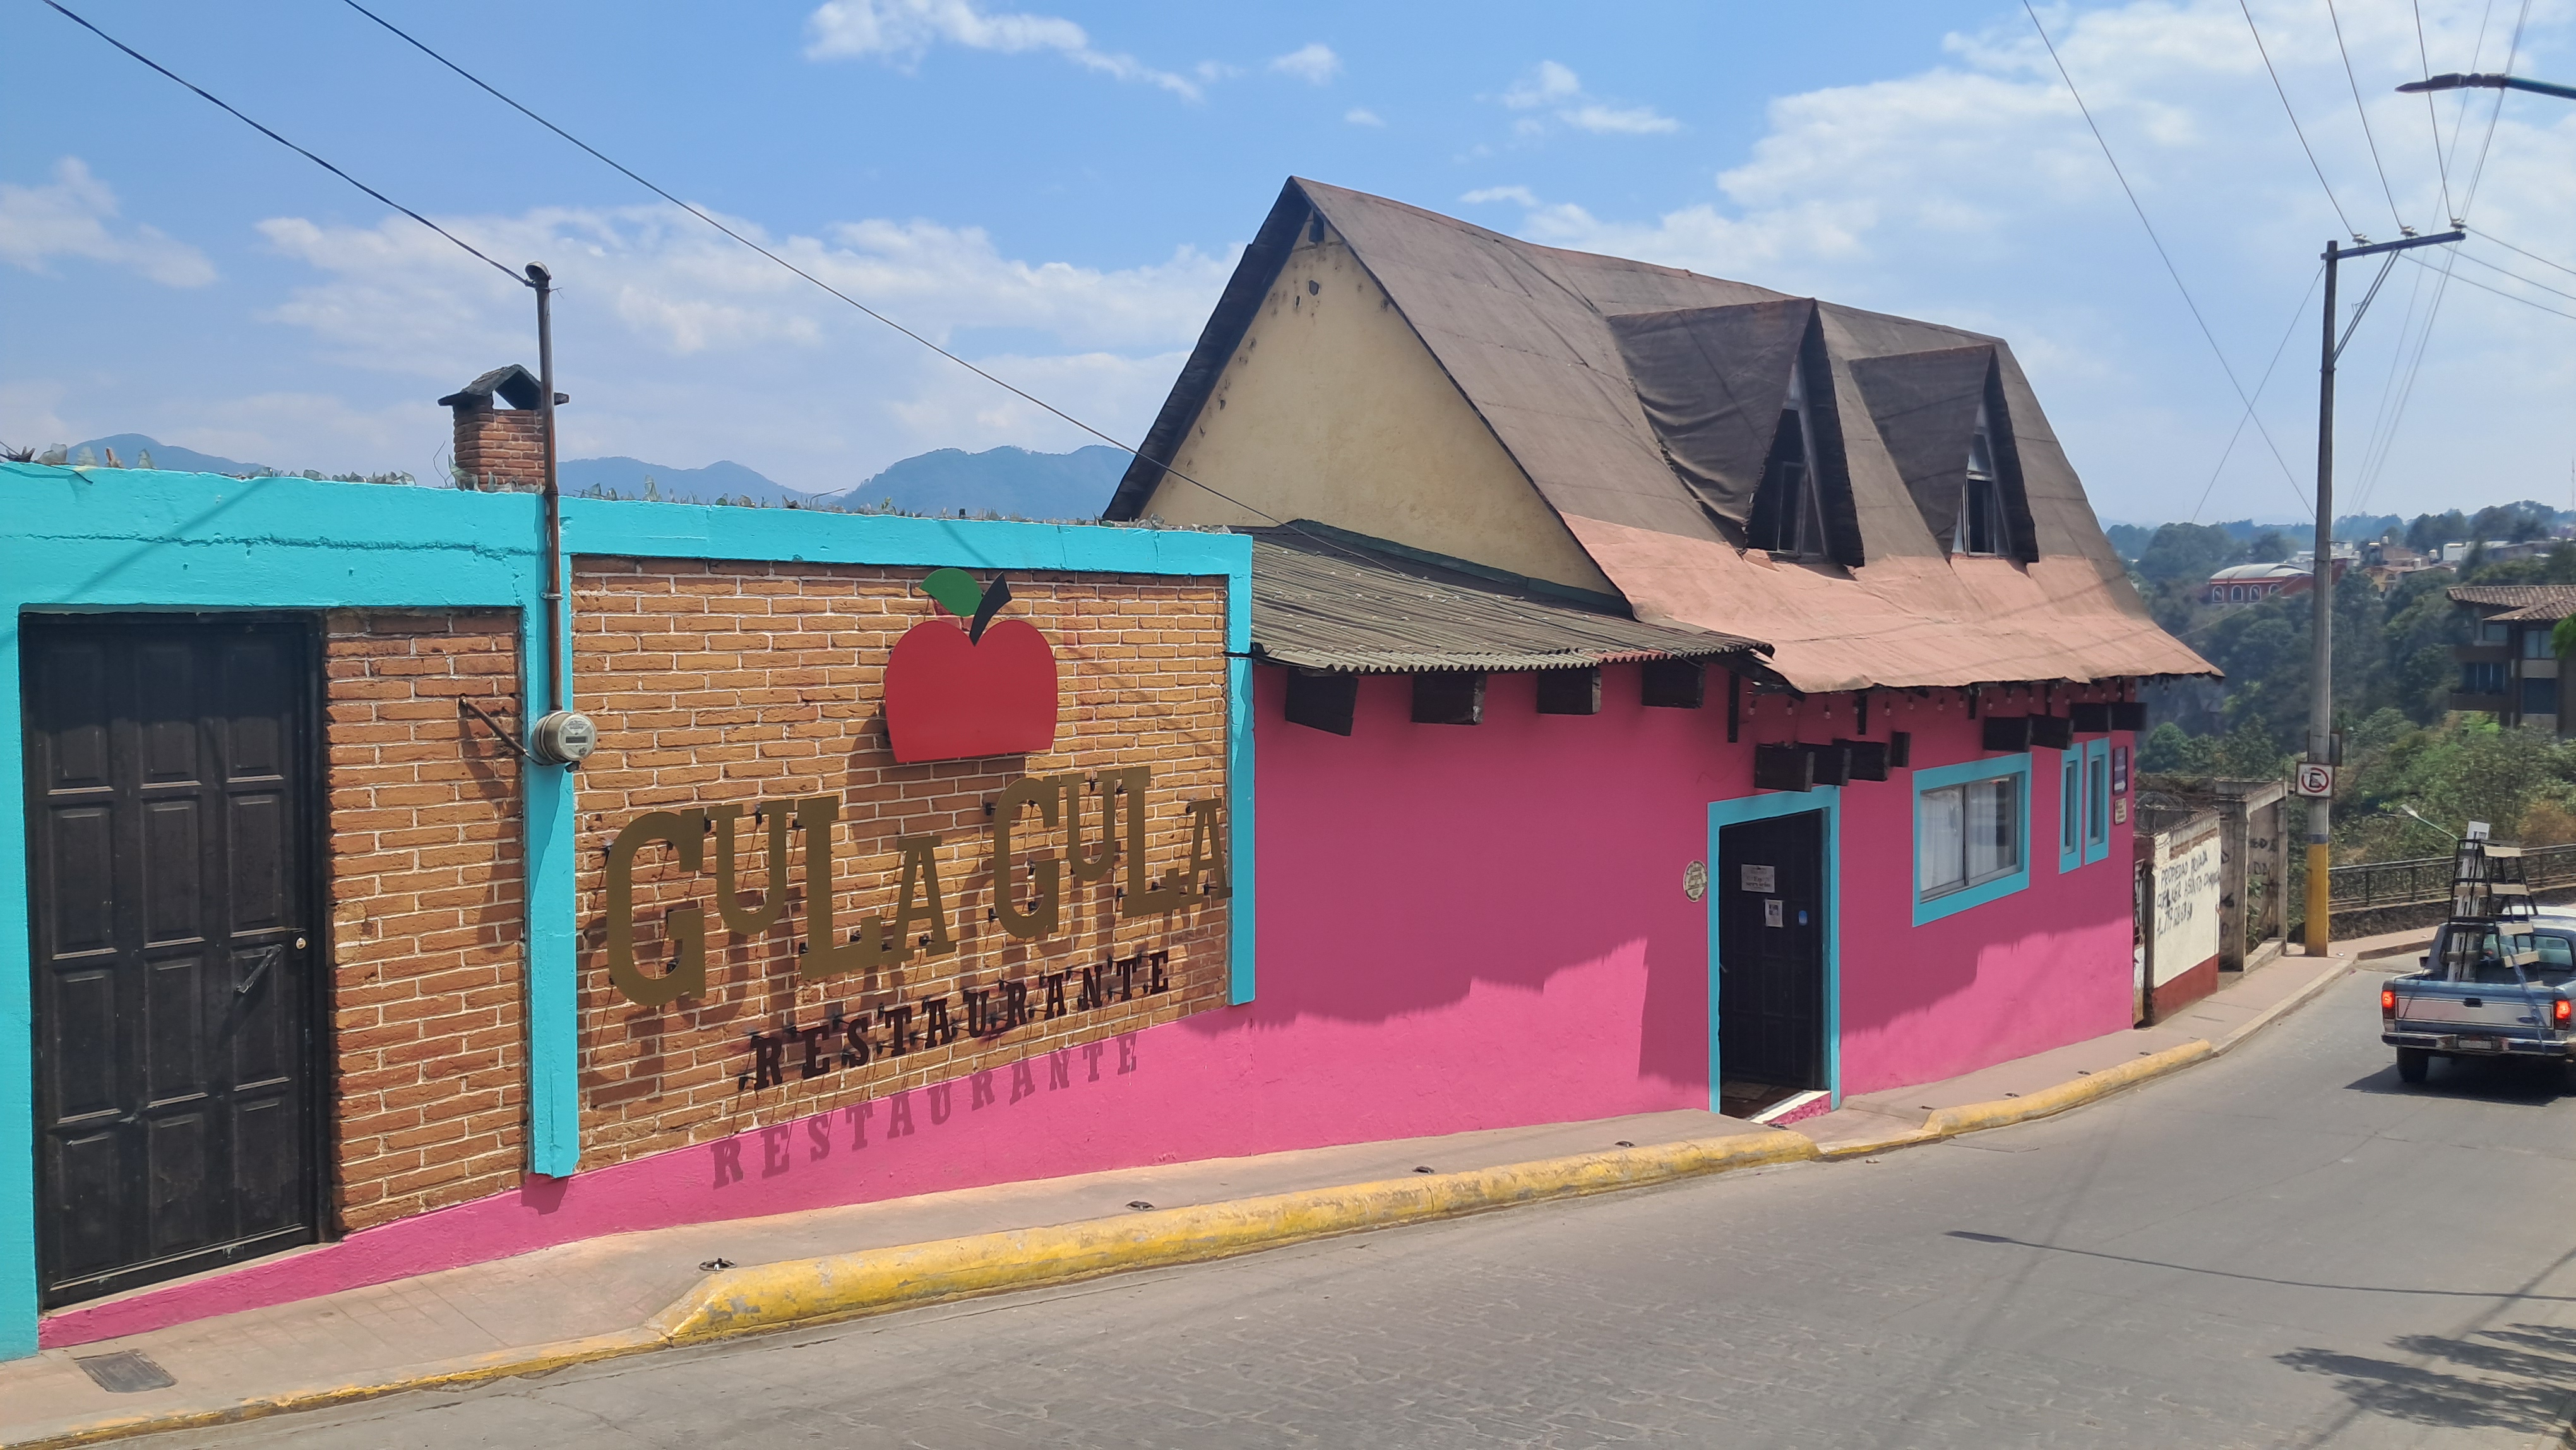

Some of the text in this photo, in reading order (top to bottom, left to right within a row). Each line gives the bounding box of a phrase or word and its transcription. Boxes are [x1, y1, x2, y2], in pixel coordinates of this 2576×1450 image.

[2309, 772, 2321, 788] E
[606, 765, 1232, 1006] GULA GULA
[752, 950, 1169, 1091] RESTAURANTE
